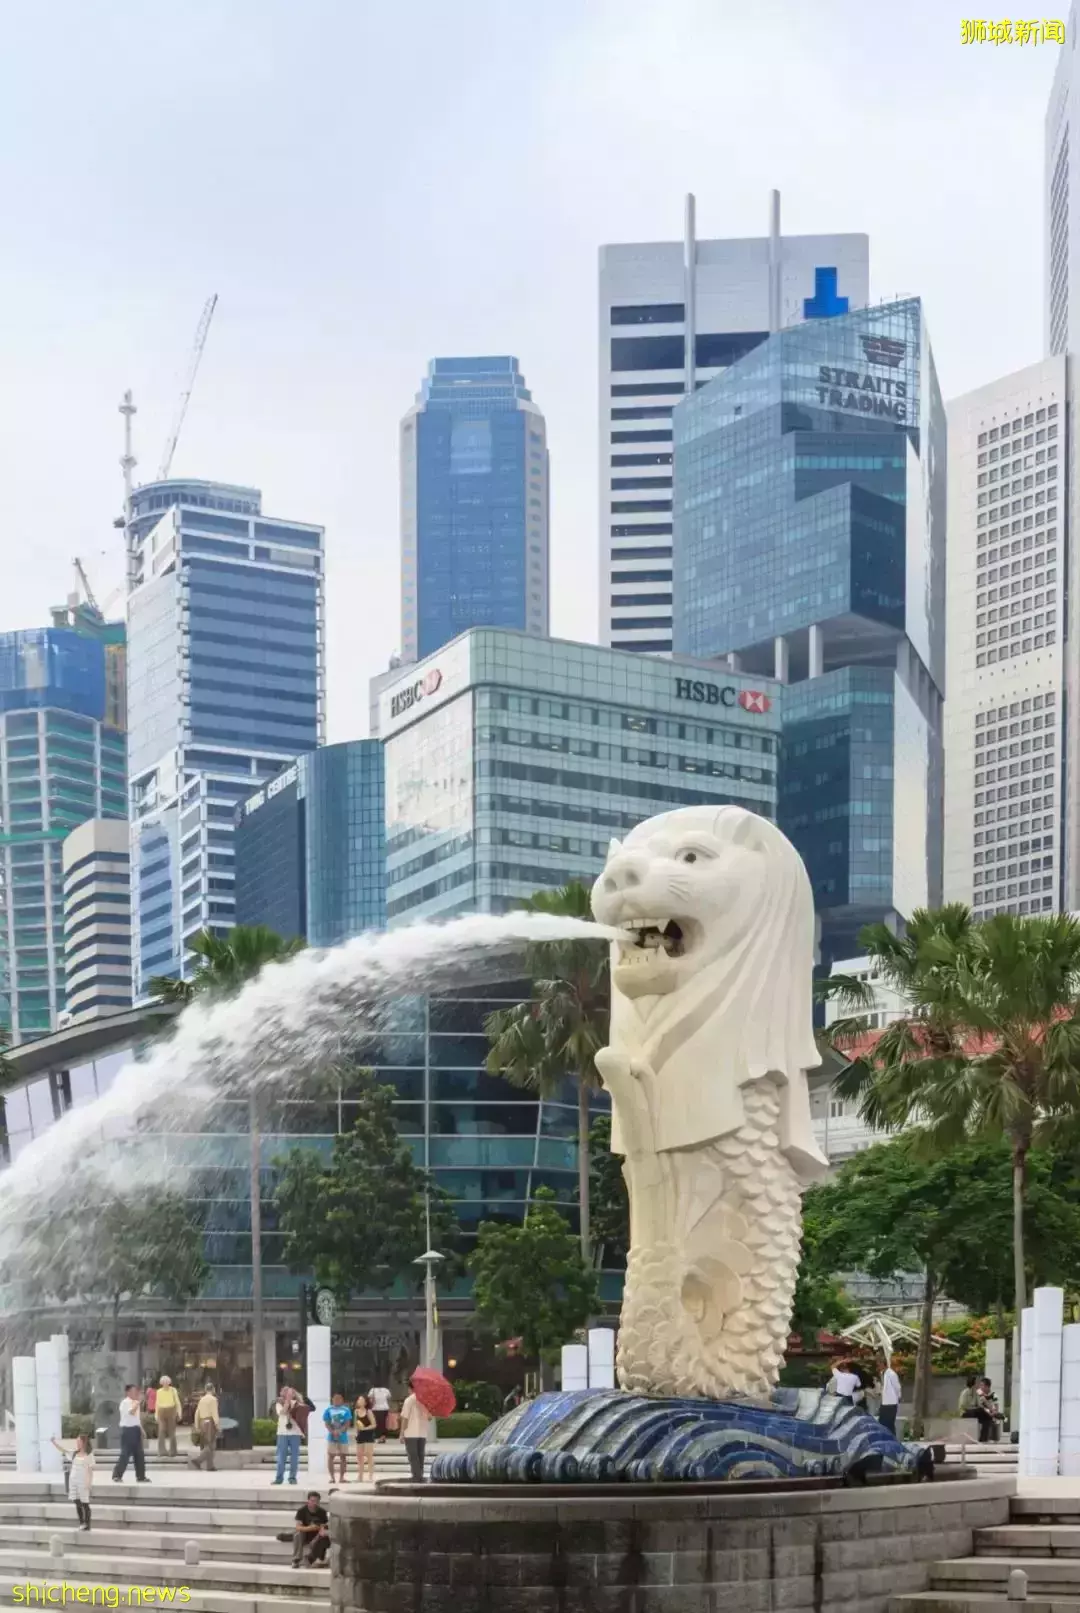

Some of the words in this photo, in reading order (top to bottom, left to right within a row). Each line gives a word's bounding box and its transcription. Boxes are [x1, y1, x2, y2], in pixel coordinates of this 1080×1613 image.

[818, 366, 907, 399] STRAITS
[815, 385, 907, 419] TRADING
[391, 680, 423, 718] HSBC
[675, 677, 736, 707] HSBC
